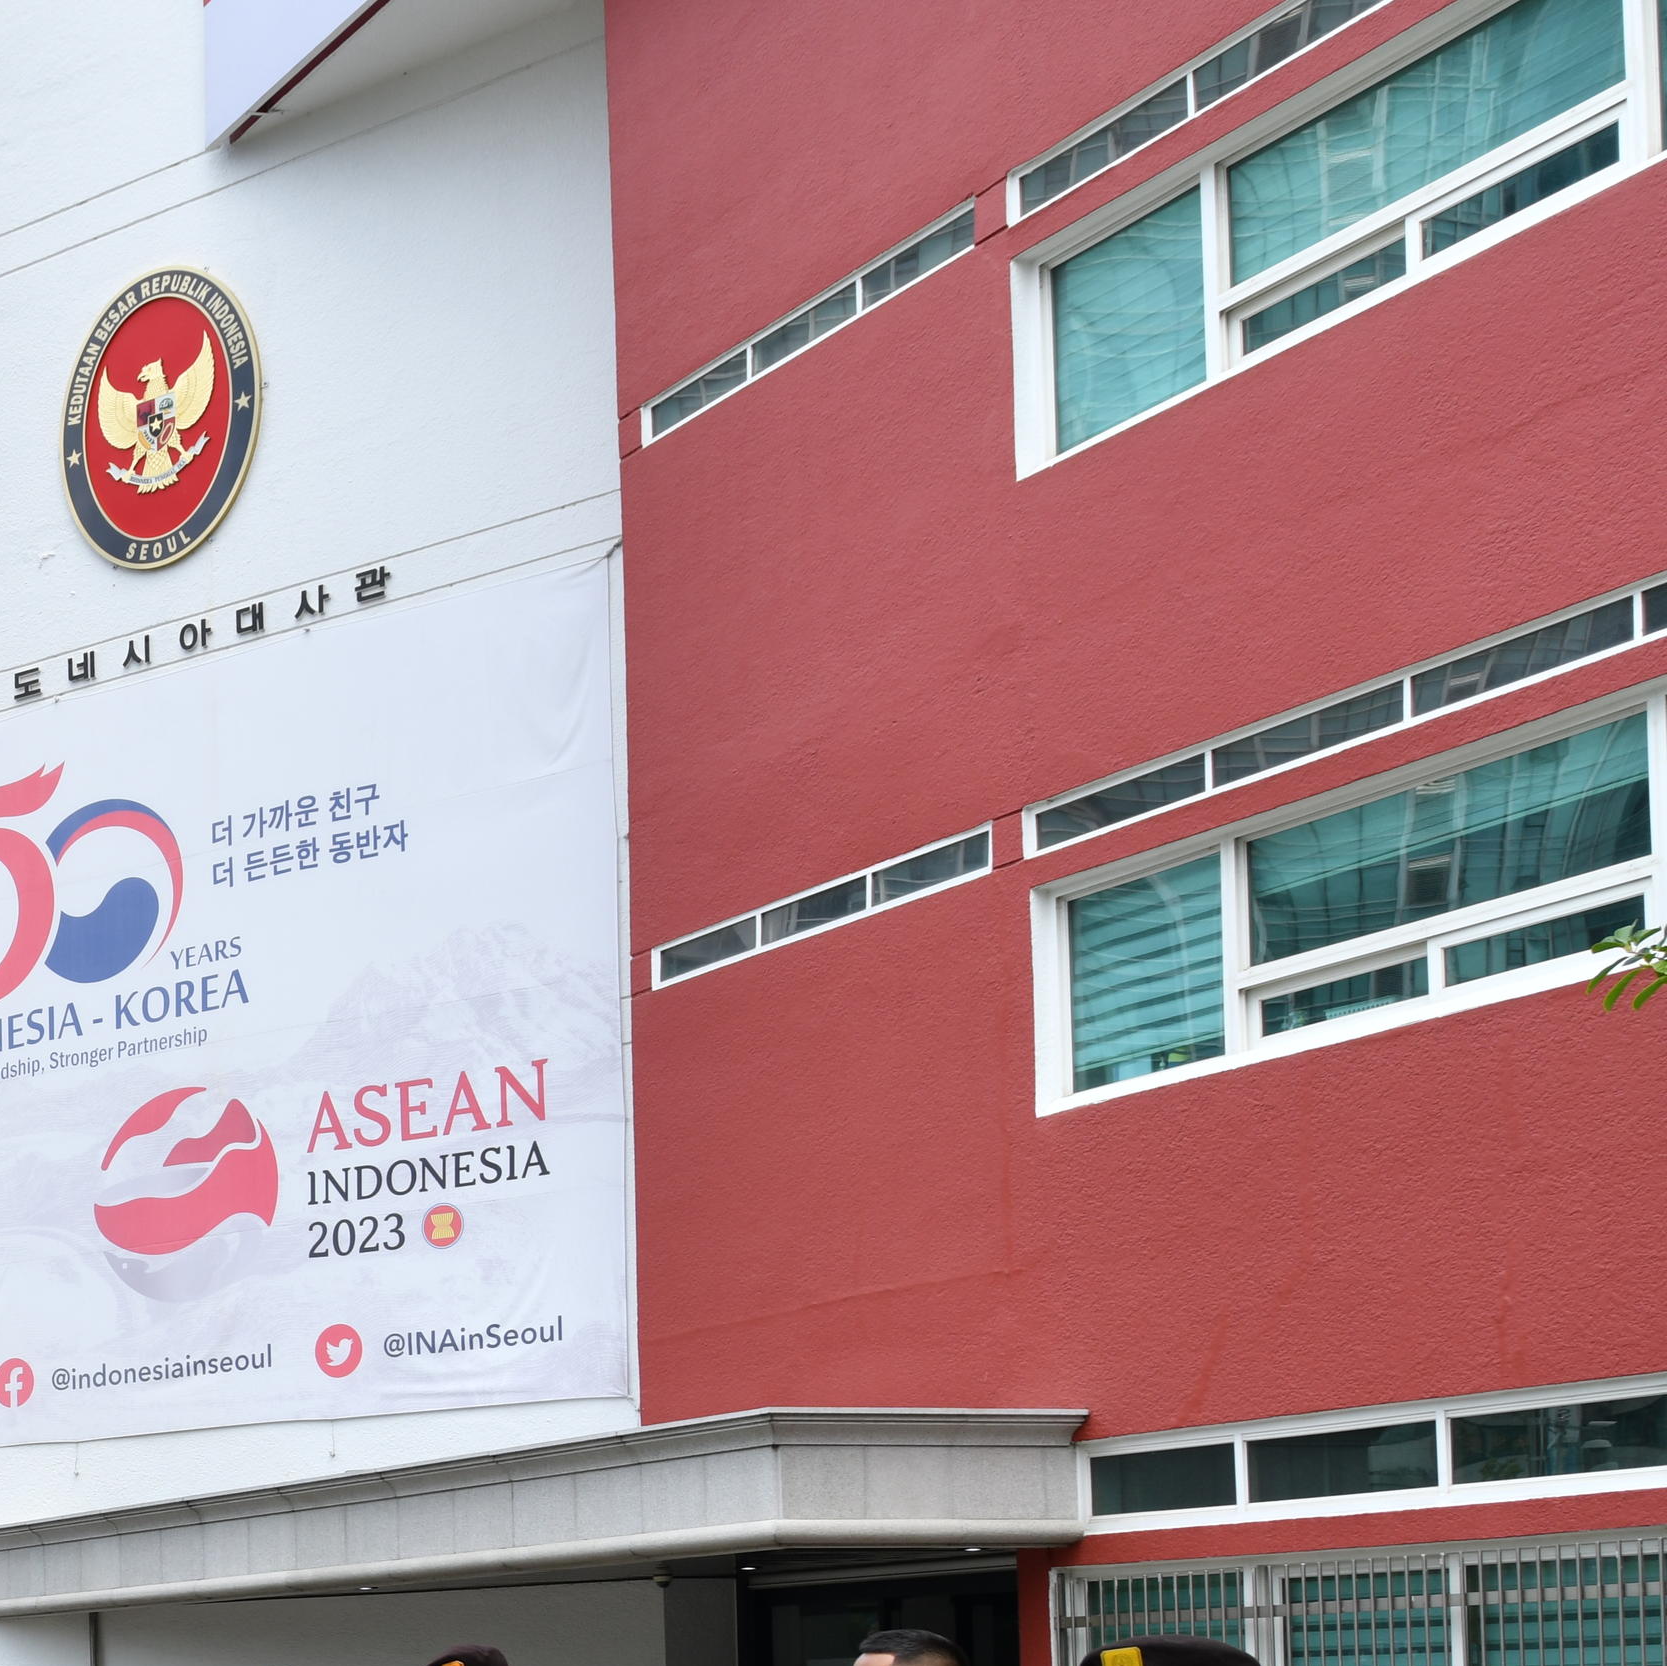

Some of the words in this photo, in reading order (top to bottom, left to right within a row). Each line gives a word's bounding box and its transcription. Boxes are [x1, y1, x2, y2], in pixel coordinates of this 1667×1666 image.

[67, 343, 101, 426] KEDUTAAN
[94, 292, 137, 340] BESAR
[140, 274, 210, 301] REPUBLIK
[205, 292, 248, 369] INDONESIA
[125, 529, 191, 561] SEOUL
[210, 814, 234, 848] 더
[241, 793, 319, 841] 가까운
[327, 782, 382, 826] 친구
[210, 857, 236, 890] 더
[242, 837, 320, 885] 든든한
[327, 820, 410, 867] 동반자
[169, 935, 244, 972] YEARS
[114, 967, 250, 1031] KOREA
[49, 1042, 114, 1075] Stronger
[116, 1026, 208, 1066] Partnership
[307, 1057, 550, 1153] ASEAN
[307, 1141, 551, 1206] INDONESIA
[307, 1212, 406, 1260] 2023
[382, 1316, 565, 1360] @INAinSeoul
[50, 1343, 273, 1393] @indonesiainseoul
